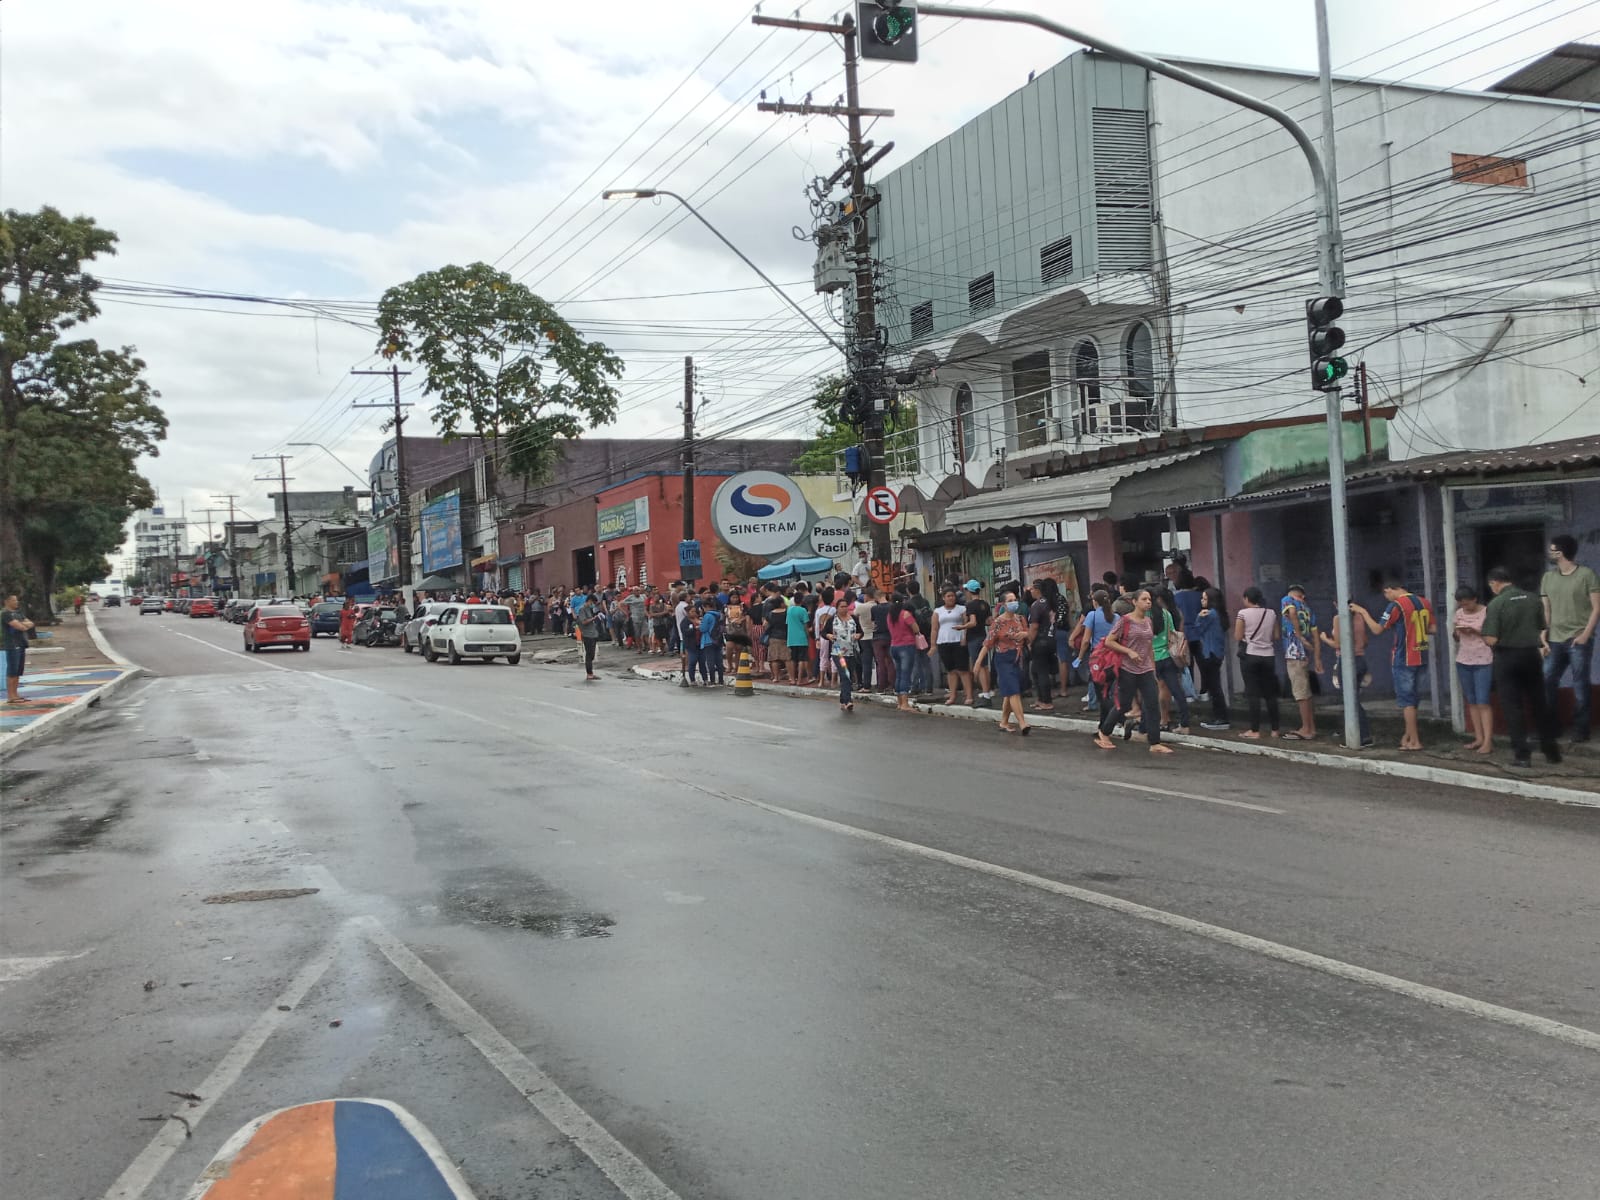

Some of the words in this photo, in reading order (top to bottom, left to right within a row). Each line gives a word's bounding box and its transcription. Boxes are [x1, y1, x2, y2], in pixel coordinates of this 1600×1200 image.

[874, 494, 891, 515] E
[729, 521, 797, 535] SINETRAM
[814, 527, 850, 536] Passa
[817, 542, 847, 553] Fácil
[1411, 608, 1430, 643] 10
